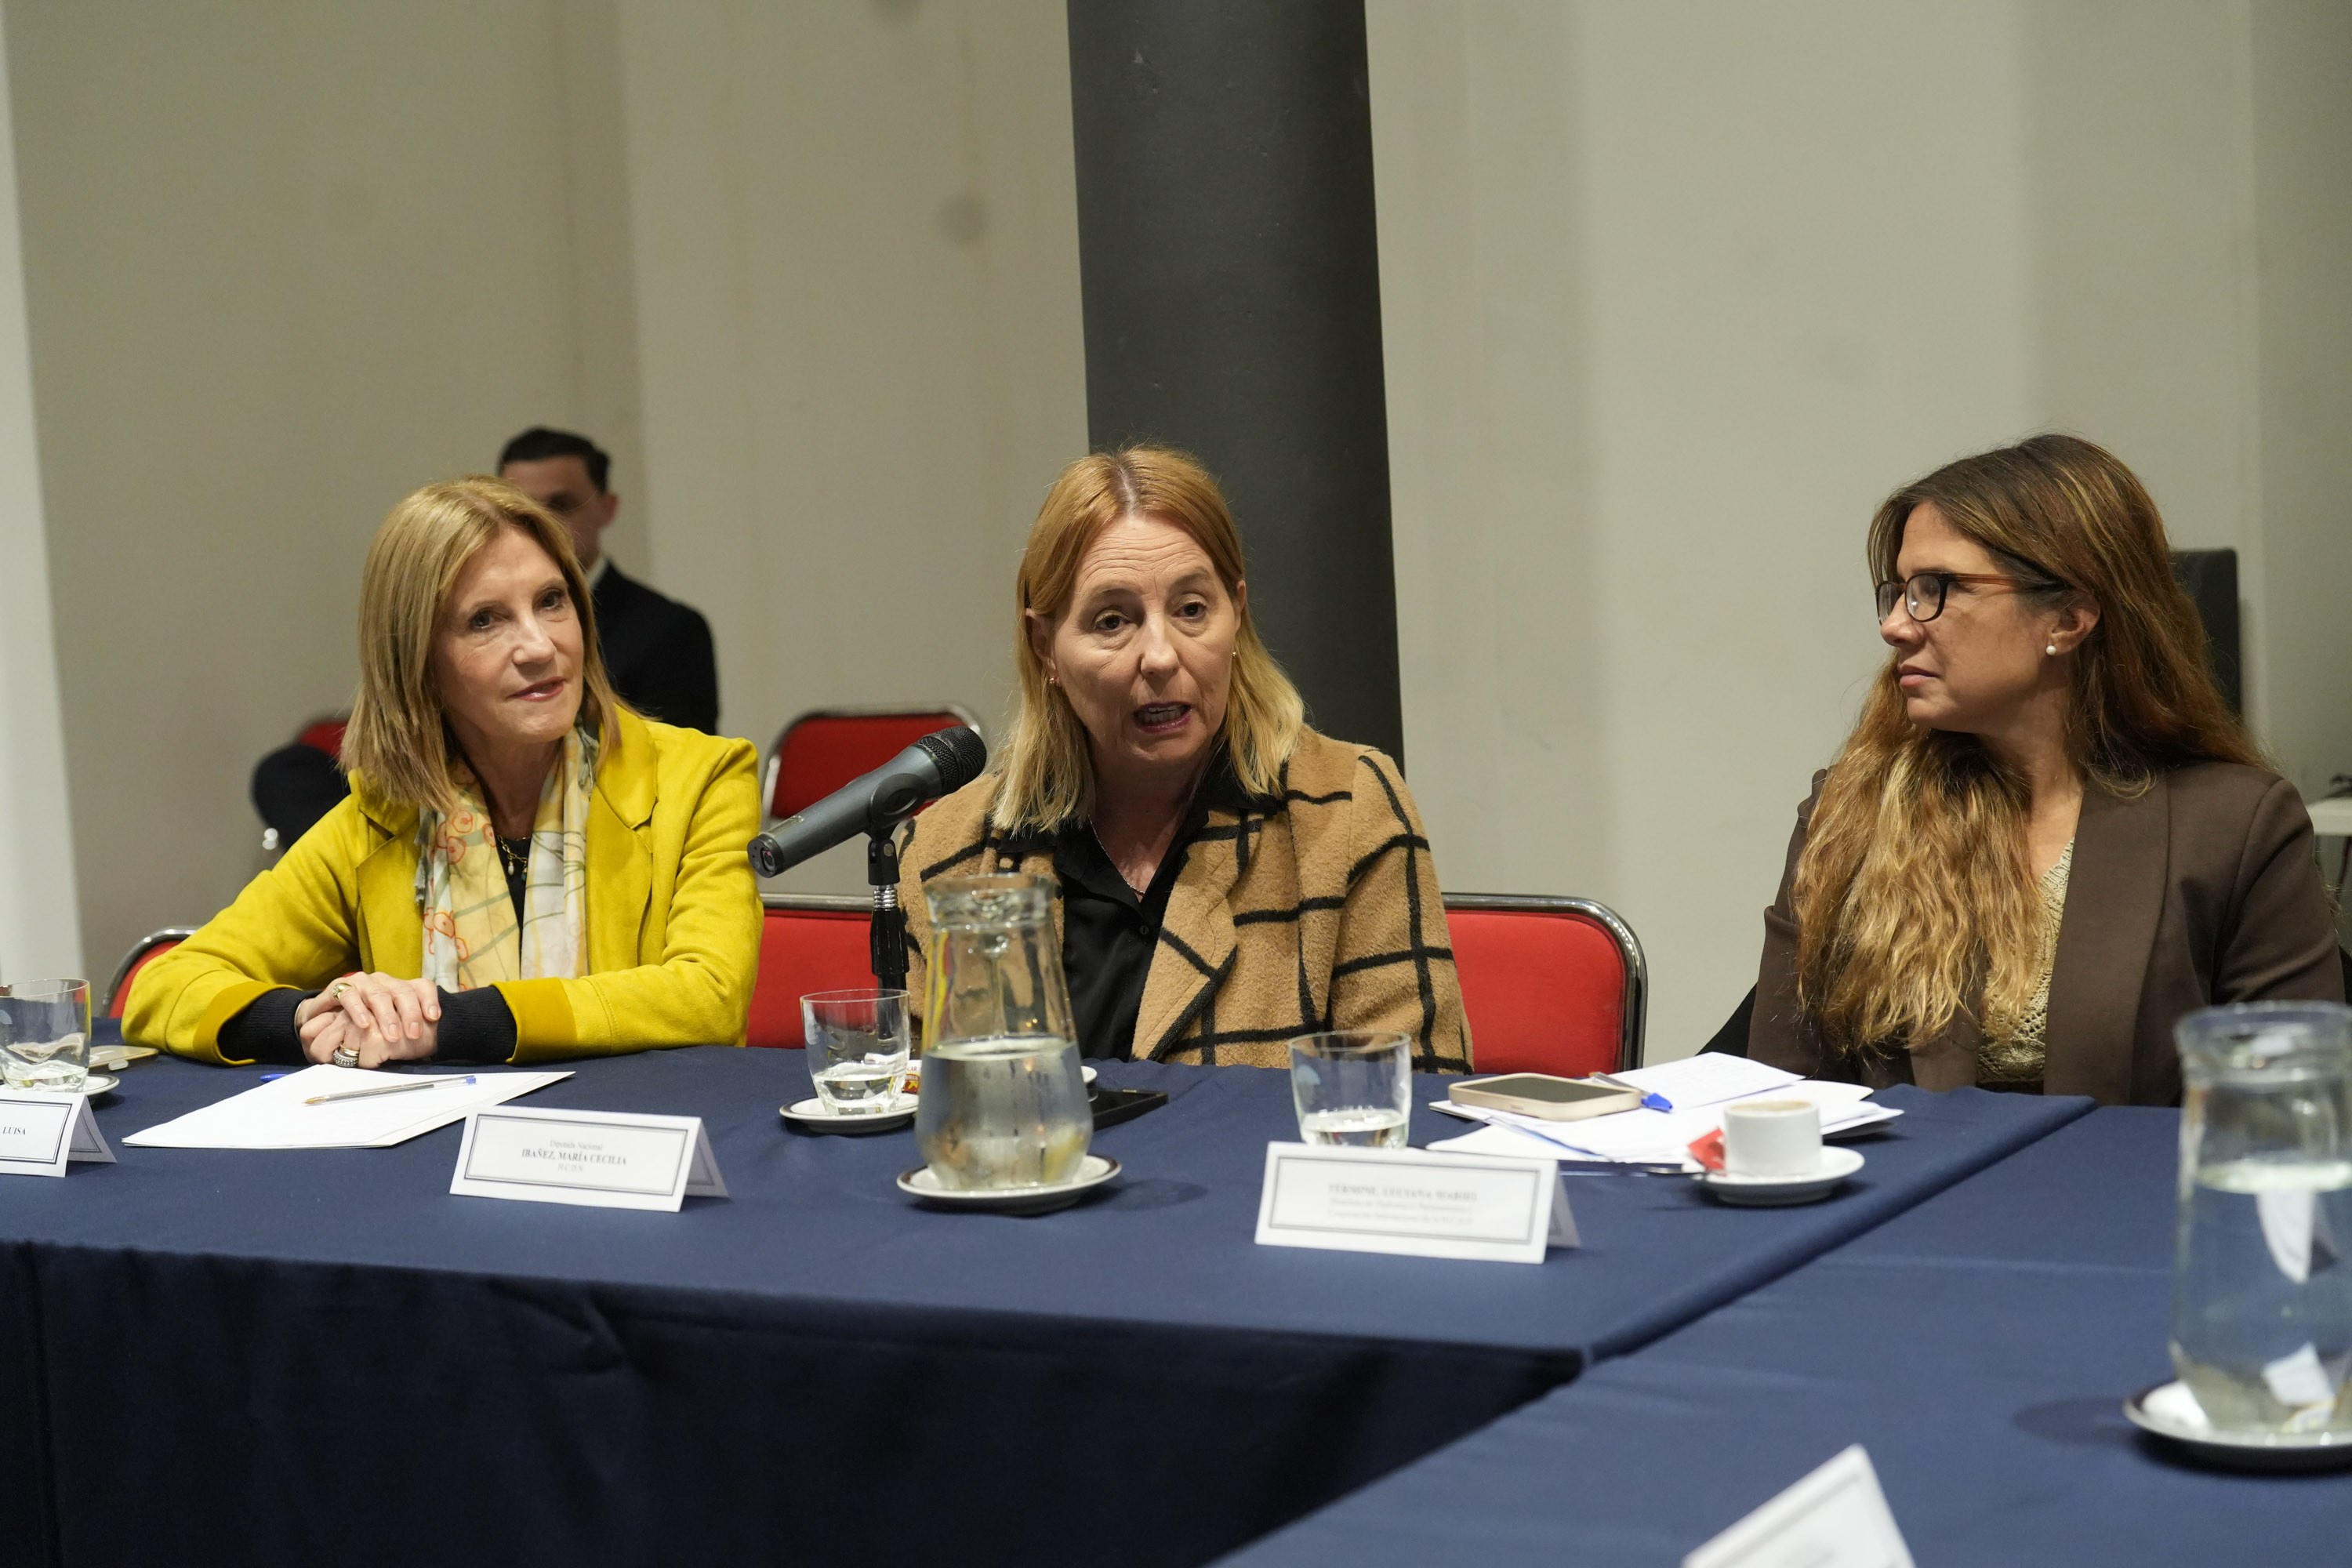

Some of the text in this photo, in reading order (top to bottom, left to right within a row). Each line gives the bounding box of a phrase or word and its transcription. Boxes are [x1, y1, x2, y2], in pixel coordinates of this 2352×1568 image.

[2, 1126, 26, 1135] LUISA
[558, 1150, 587, 1162] MARÍA
[590, 1154, 626, 1165] CECILIA
